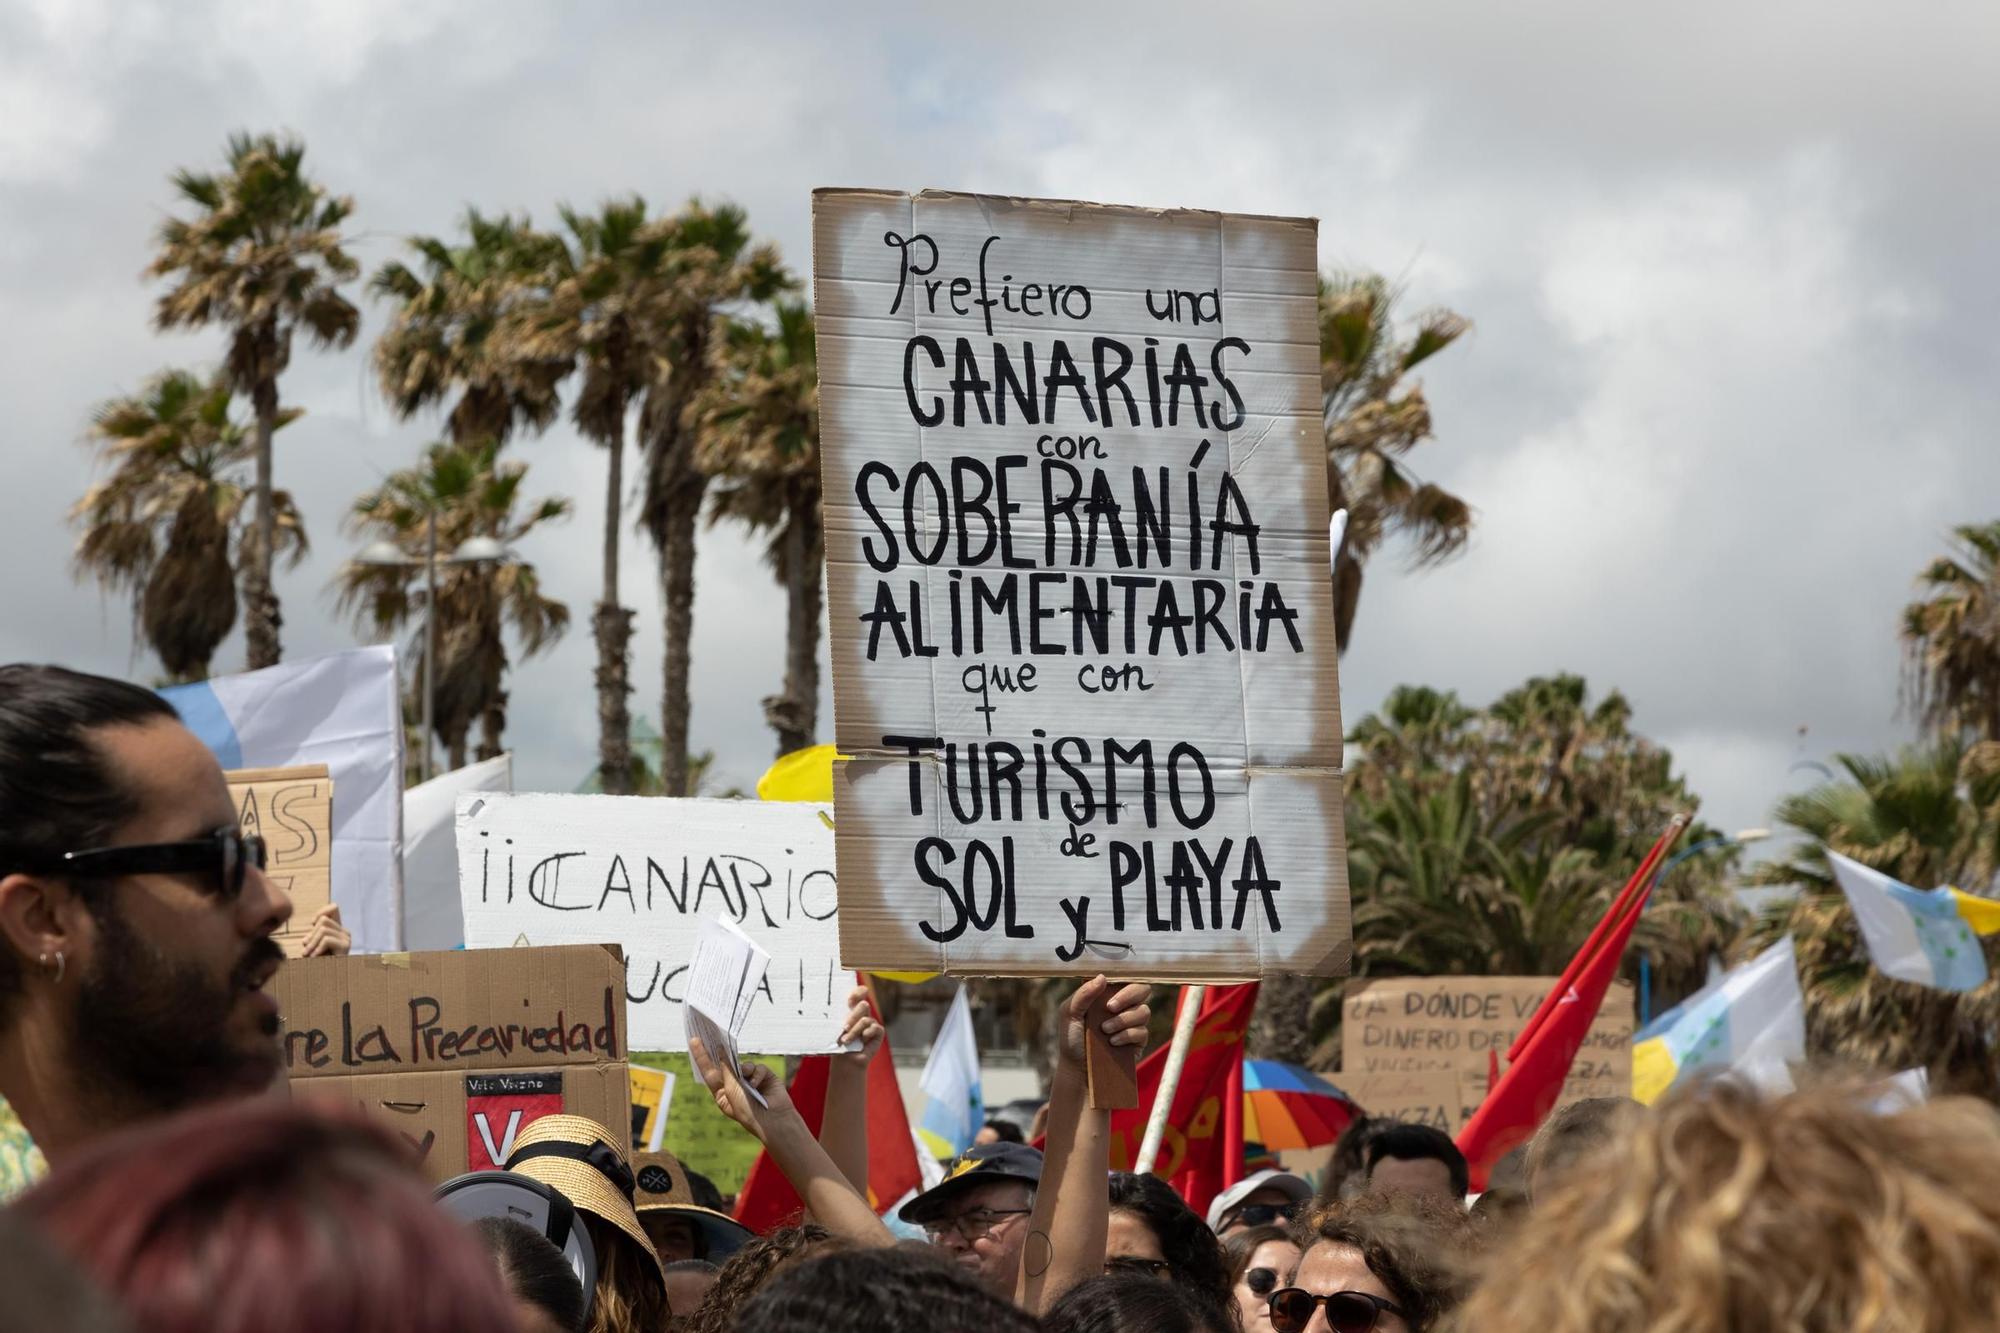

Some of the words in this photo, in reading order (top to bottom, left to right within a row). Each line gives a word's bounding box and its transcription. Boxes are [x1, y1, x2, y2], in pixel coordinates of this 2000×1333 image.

[884, 231, 1091, 336] Prefiero
[1146, 288, 1221, 325] una
[1036, 434, 1108, 460] con
[855, 438, 1260, 575] SOBERANÍA
[962, 662, 1037, 735] que
[1078, 662, 1155, 693] con
[239, 784, 318, 864] AS
[1060, 823, 1100, 858] de
[914, 835, 1035, 943] SOL
[1055, 896, 1090, 962] y
[1110, 835, 1281, 933] PLAYA
[1404, 985, 1502, 1019] DÓNDE
[284, 1028, 332, 1068] re
